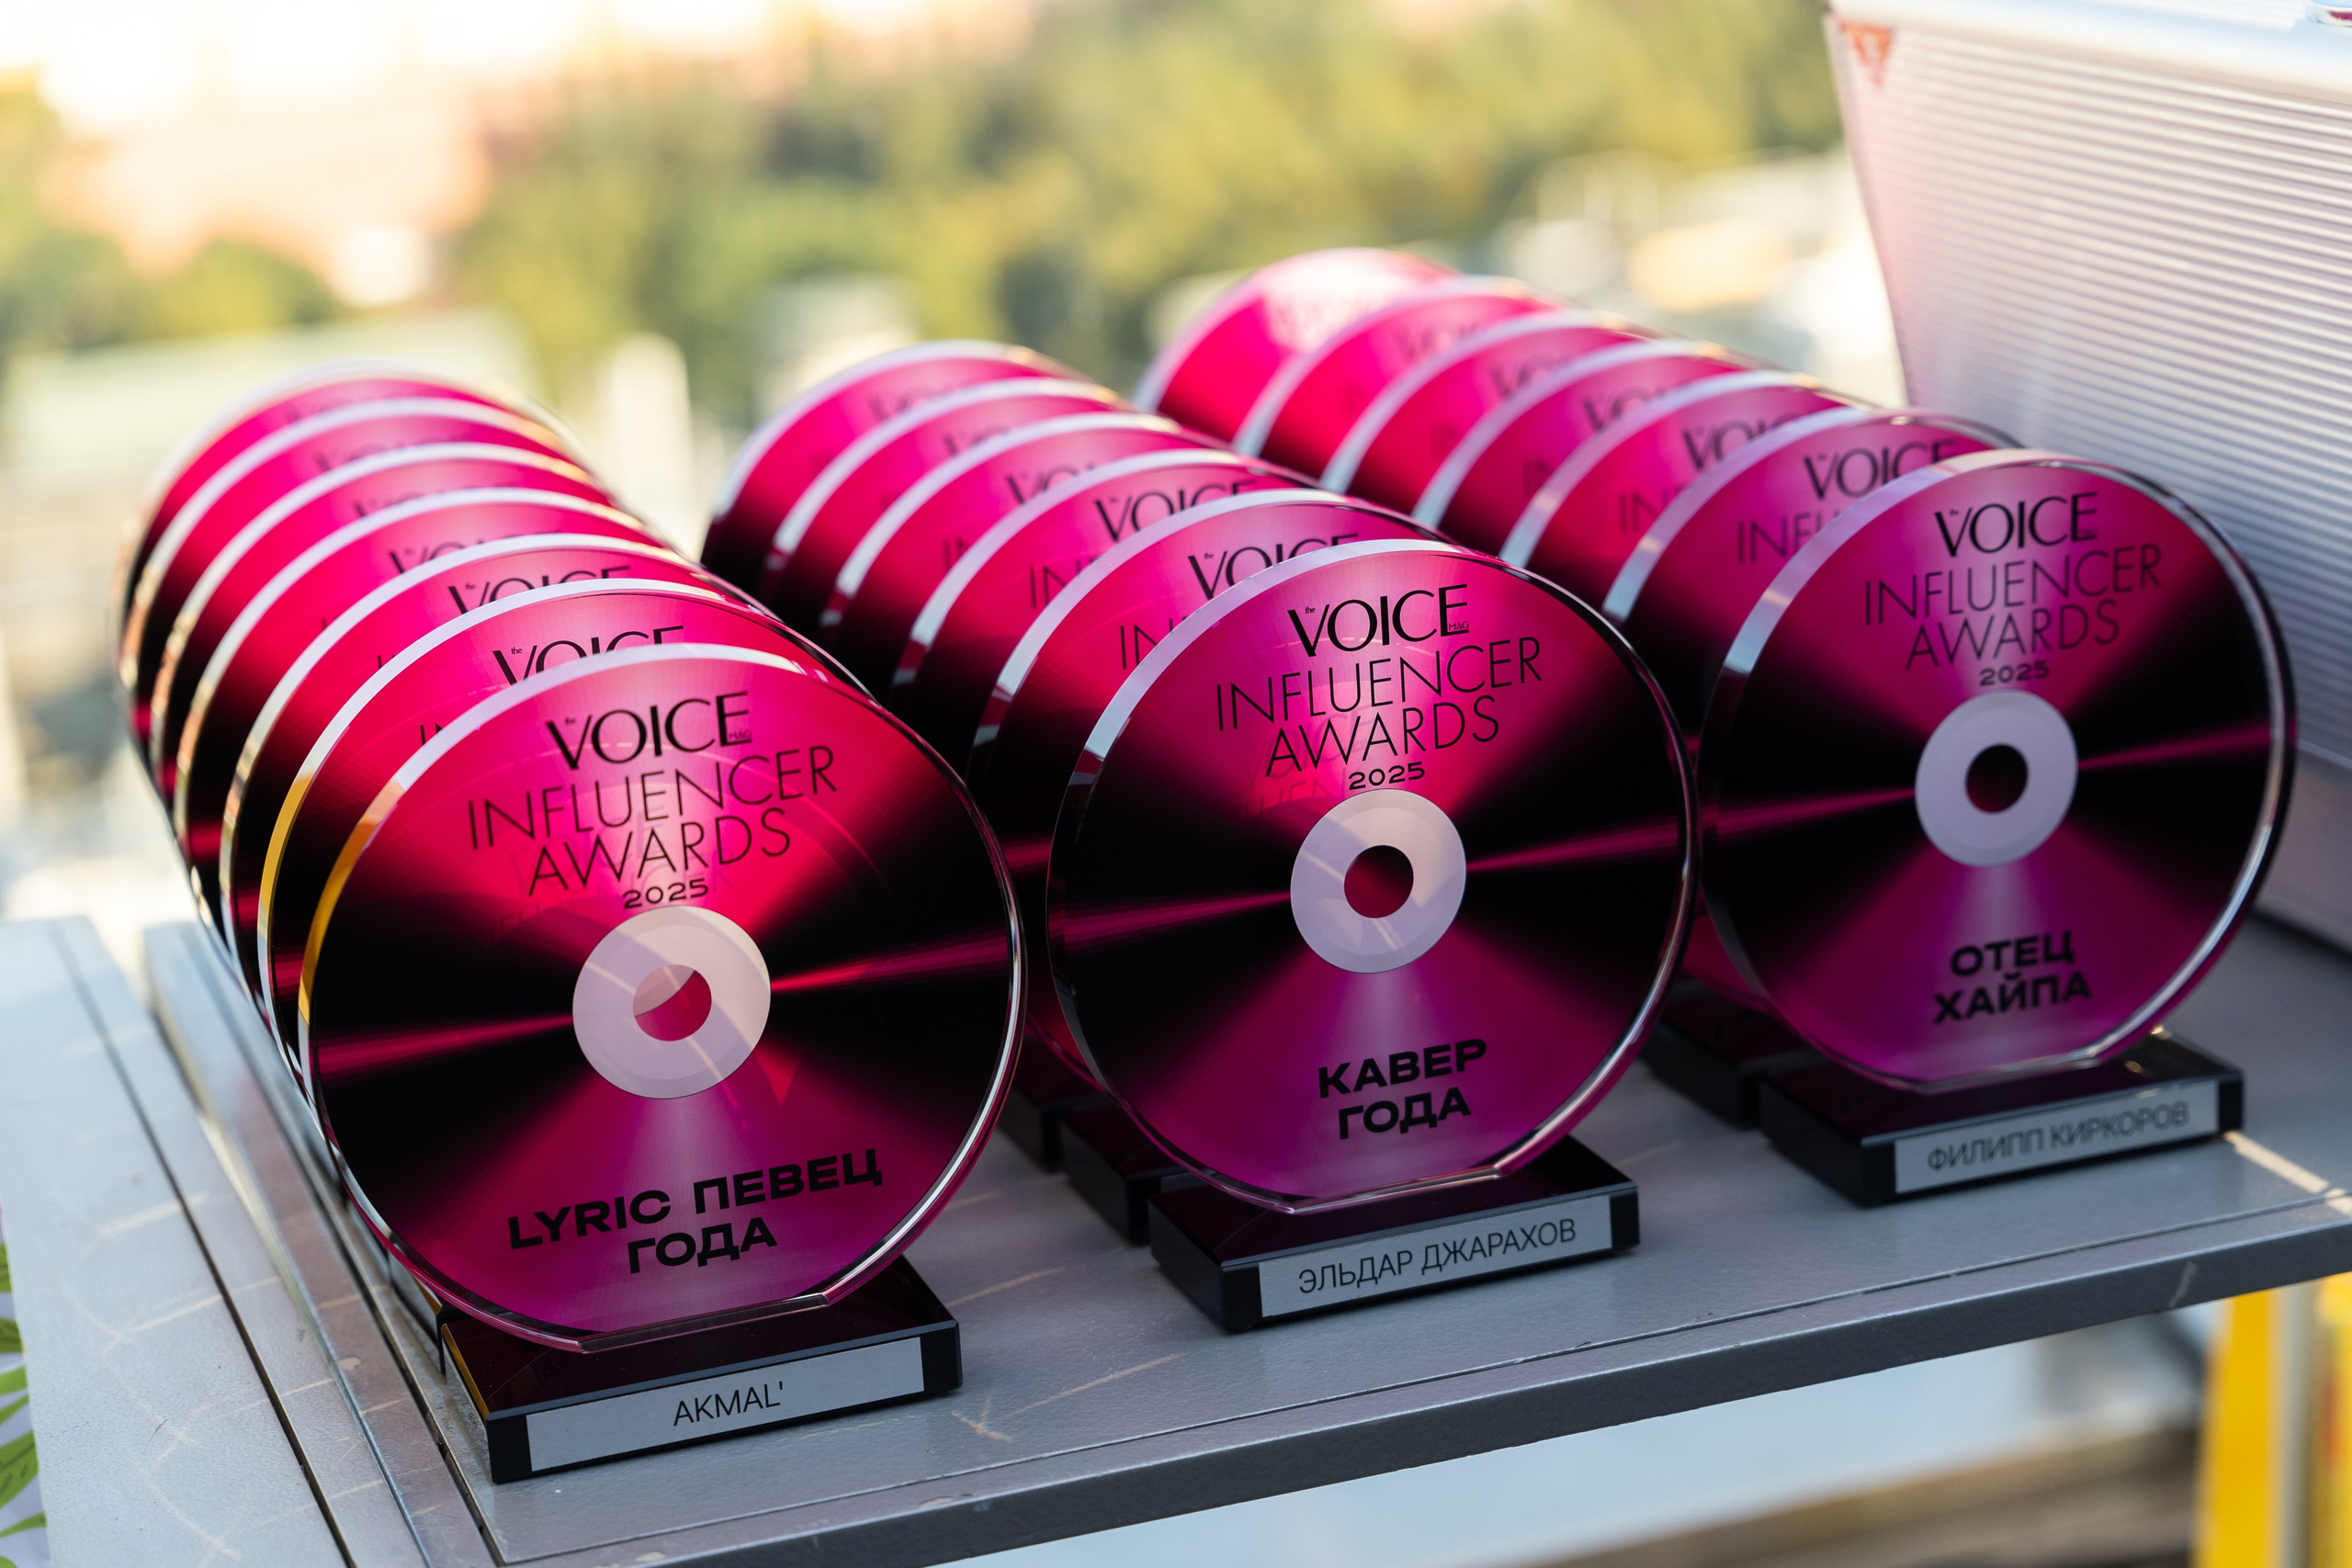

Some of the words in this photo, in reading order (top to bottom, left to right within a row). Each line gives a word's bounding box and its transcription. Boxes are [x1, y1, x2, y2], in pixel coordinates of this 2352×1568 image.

[1934, 491, 2098, 558] VOICE
[1865, 543, 2162, 626] INFLUENCER
[1287, 583, 1469, 658] VOICE
[1905, 599, 2120, 671] AWARDS
[1217, 636, 1543, 732] INFLUENCER
[1980, 660, 2050, 687] 2025
[546, 691, 752, 771] VOICE
[1265, 695, 1499, 777] AWARDS
[468, 745, 837, 850] INFLUENCER
[1348, 761, 1425, 791] 2025
[528, 807, 791, 897] AWARDS
[623, 878, 709, 909] 2025
[1951, 931, 2075, 977] ОТЕЦ
[1933, 972, 2092, 1024] ХАЙПА
[1317, 1038, 1487, 1099] КАВЕР
[1338, 1087, 1471, 1140] ГОДА
[1928, 1127, 2045, 1171] ФИЛИПП
[2050, 1100, 2190, 1148] КИРКОРОВ
[508, 1190, 671, 1249] LYRIC
[693, 1148, 883, 1213] ПЕВЕЦ
[628, 1217, 777, 1273] ГОДА
[1297, 1249, 1413, 1294] ЭЛЬДАР
[1421, 1218, 1577, 1274] ДЖАРАХОВ
[673, 1381, 784, 1427] AKMAL'
